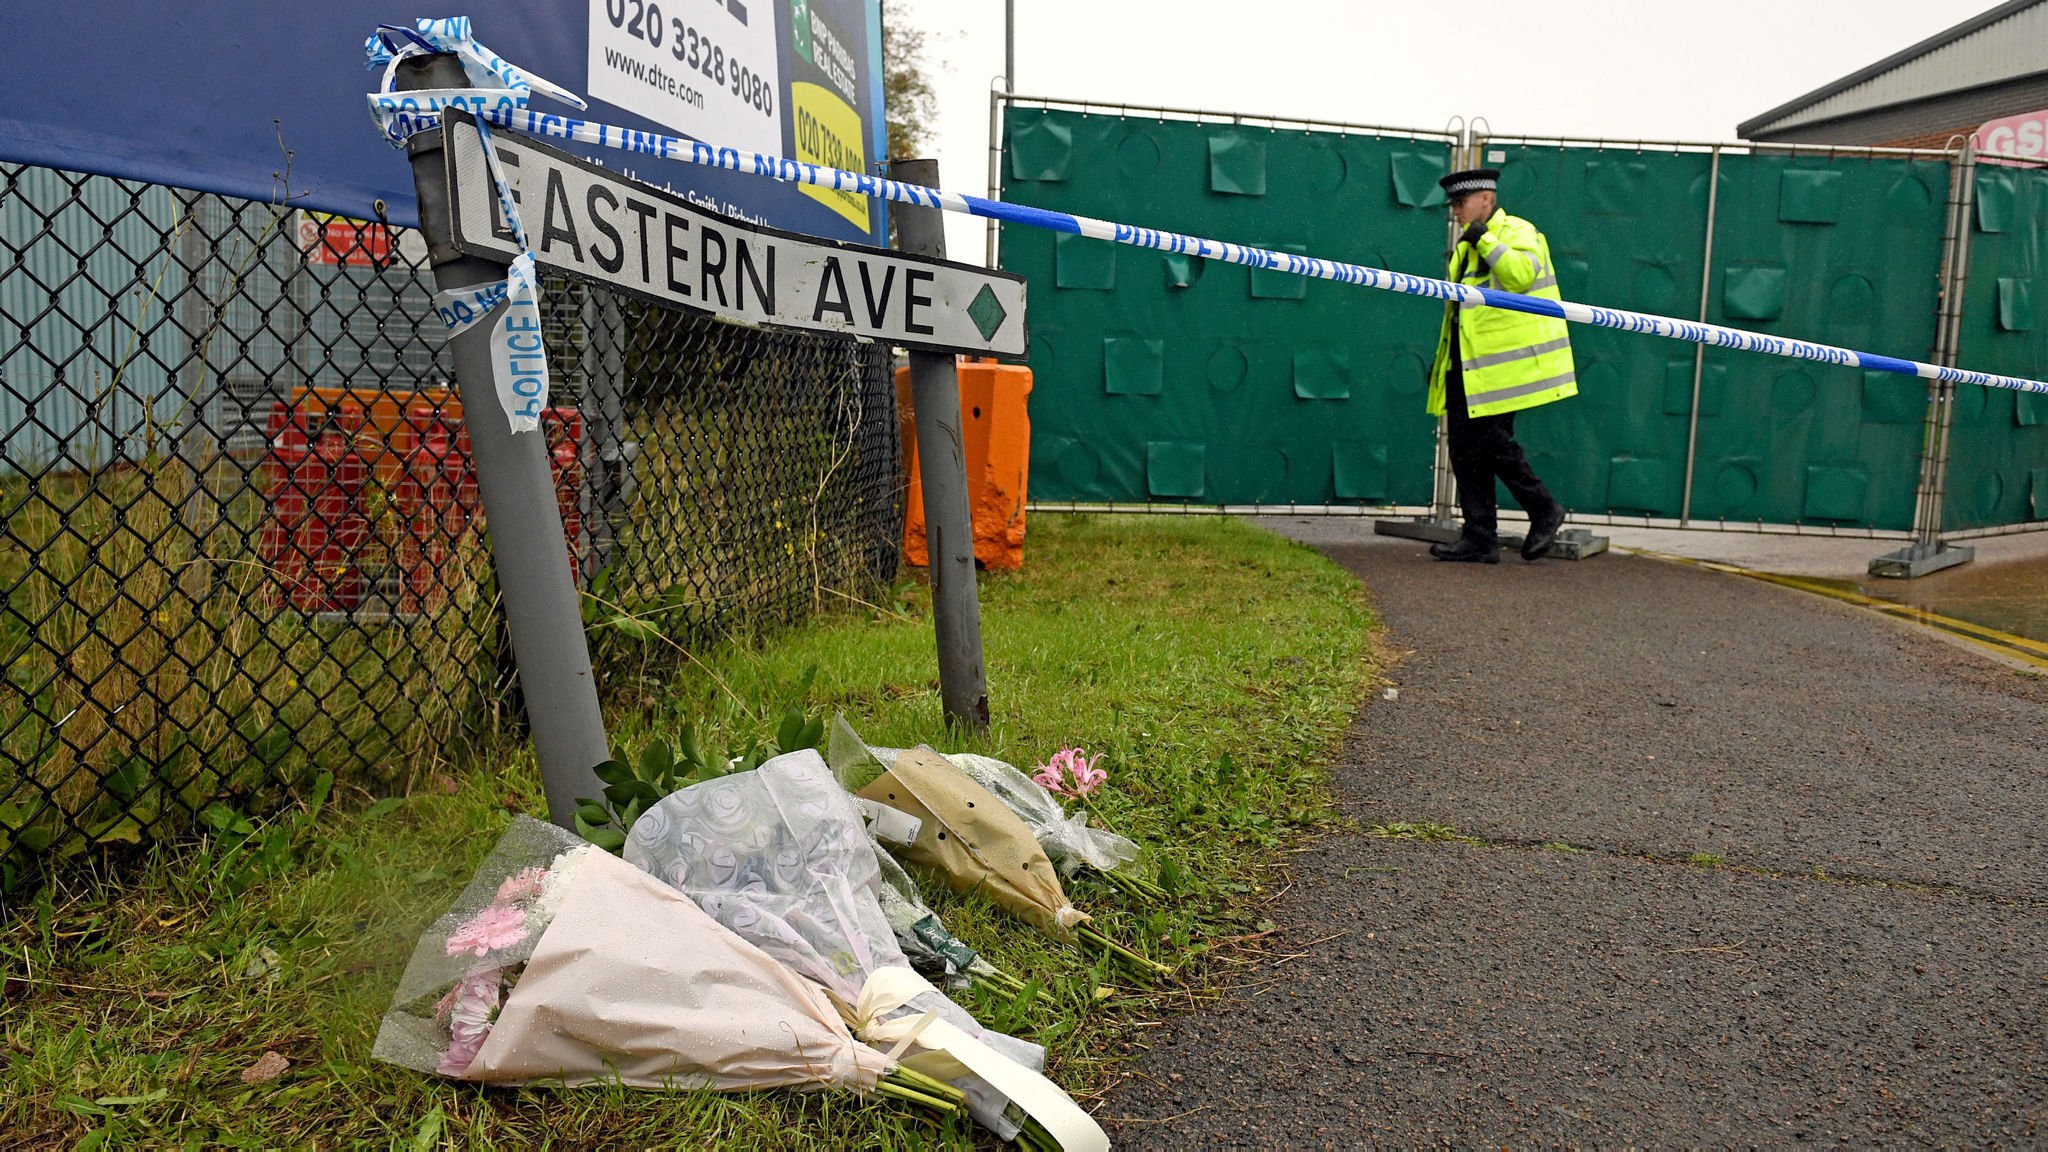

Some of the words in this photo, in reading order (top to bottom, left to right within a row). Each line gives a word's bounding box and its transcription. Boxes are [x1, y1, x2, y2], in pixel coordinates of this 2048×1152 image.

[605, 46, 704, 110] www.dtre.com
[606, 0, 663, 48] 020
[672, 17, 725, 86] 3328
[730, 58, 772, 117] 9080
[798, 105, 820, 161] 020
[1986, 120, 2048, 156] GS
[486, 145, 776, 317] EASTERN
[813, 255, 935, 336] AVE
